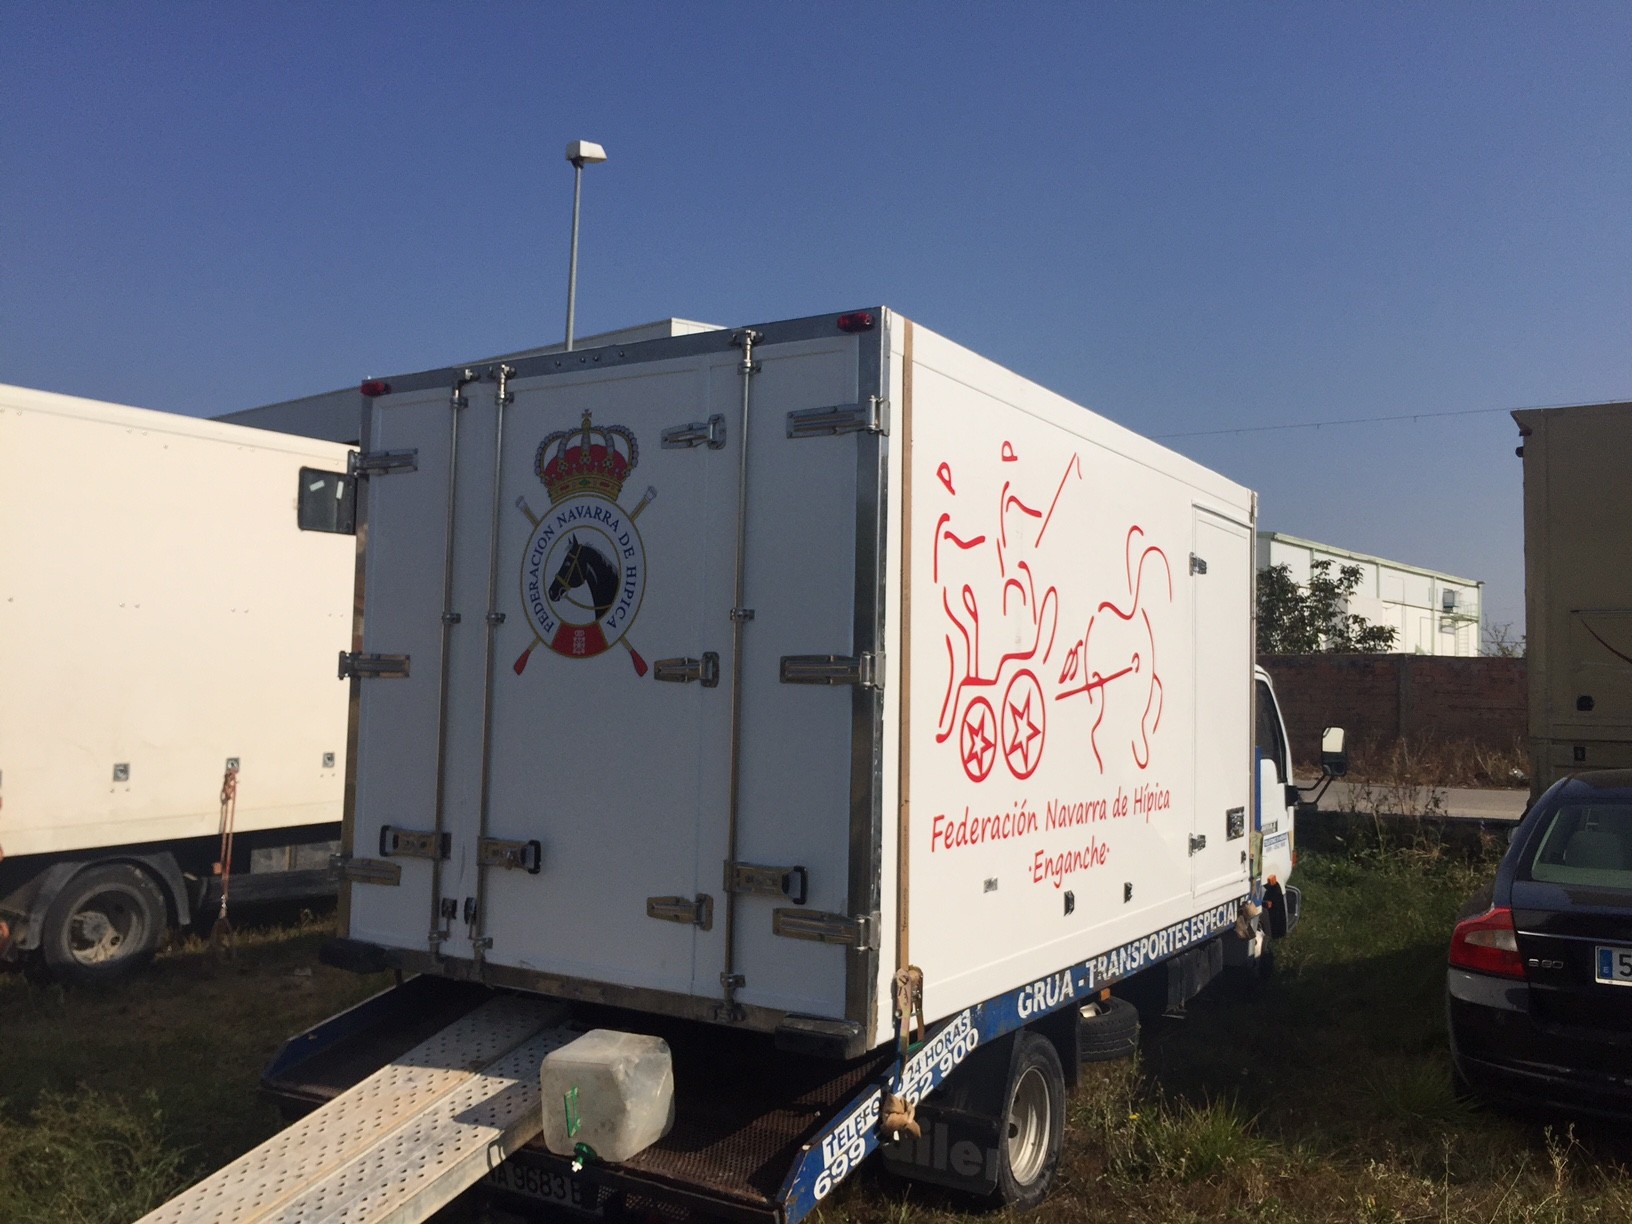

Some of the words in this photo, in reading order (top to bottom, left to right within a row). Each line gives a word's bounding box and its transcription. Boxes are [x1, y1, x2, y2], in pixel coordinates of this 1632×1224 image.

[556, 505, 620, 533] NAVARRA
[618, 532, 635, 559] DE
[529, 525, 556, 633] FEDERACION
[606, 565, 637, 630] HIPICA
[931, 799, 1038, 853] Federación
[1045, 798, 1107, 832] Navarra
[1112, 786, 1128, 819] de
[1133, 782, 1170, 824] Hípica
[1017, 969, 1074, 1019] GRUA
[1086, 921, 1189, 988] TRANSPORTES
[907, 1058, 922, 1084] 24
[925, 1016, 969, 1068] HORAS
[813, 1137, 866, 1201] 699
[939, 1027, 979, 1078] 900
